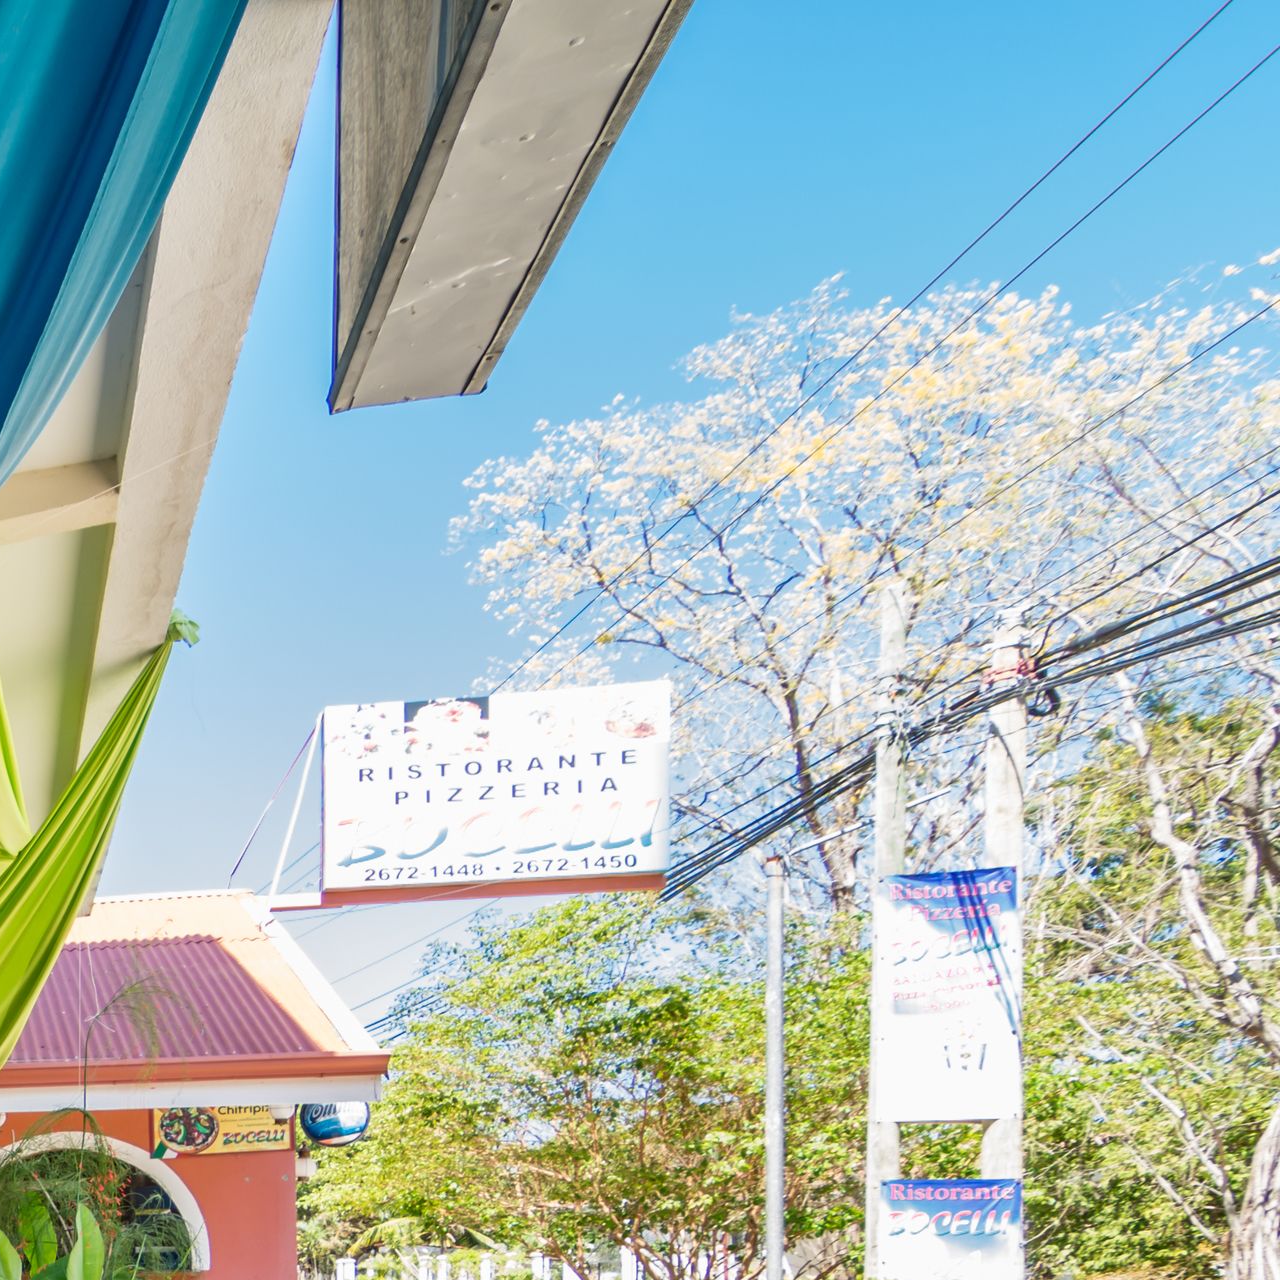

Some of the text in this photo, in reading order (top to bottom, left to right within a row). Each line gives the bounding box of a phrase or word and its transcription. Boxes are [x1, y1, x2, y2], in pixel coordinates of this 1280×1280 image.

[358, 749, 638, 783] RISTORANTE
[394, 777, 618, 805] PIZZERIA
[364, 853, 638, 882] 2672-1448 2672-1450
[889, 879, 1013, 901] Ristorante
[889, 1183, 1015, 1201] Ristorante
